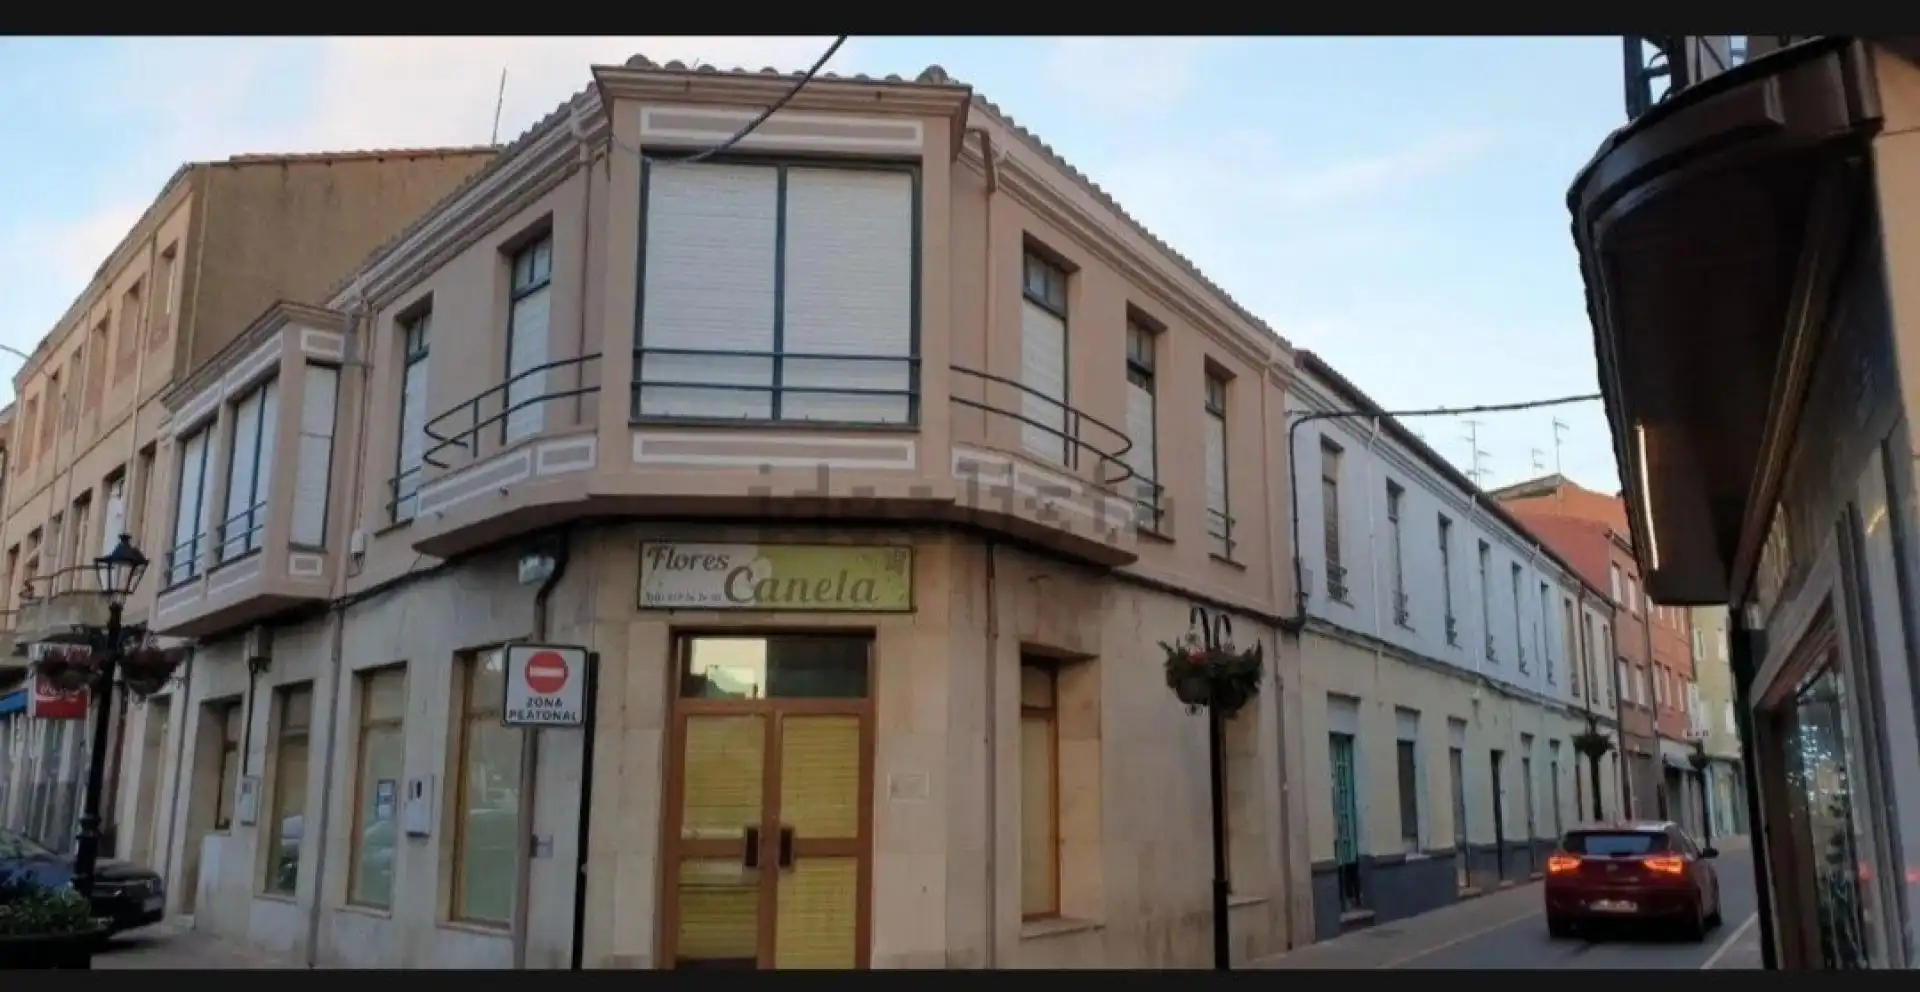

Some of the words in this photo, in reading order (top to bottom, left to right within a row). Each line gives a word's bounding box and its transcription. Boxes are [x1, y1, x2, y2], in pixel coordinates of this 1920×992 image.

[646, 544, 730, 571] Flores
[724, 566, 878, 603] Canela
[526, 697, 563, 708] ZONA
[508, 709, 577, 720] PEATONAL
